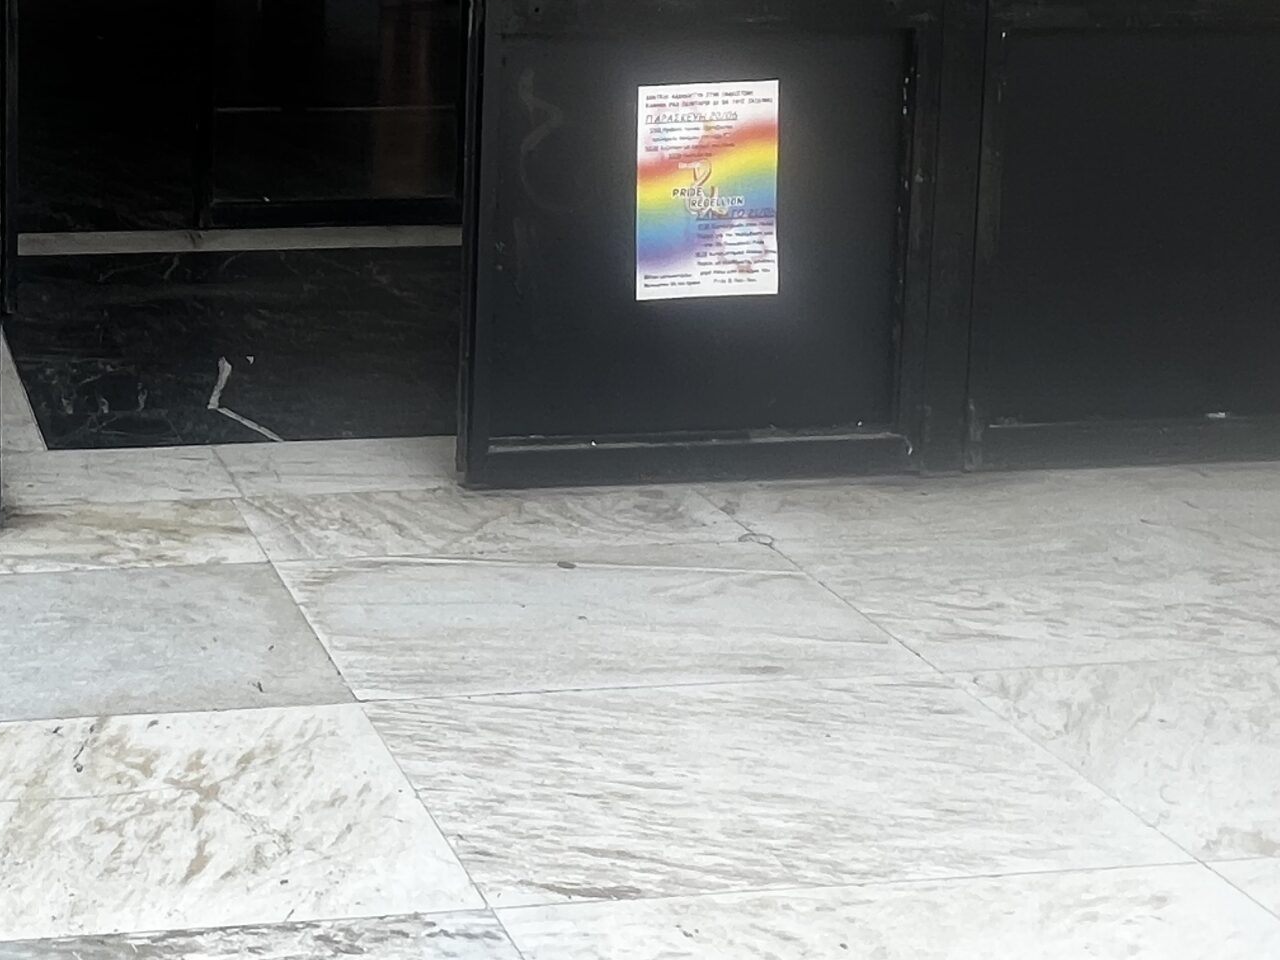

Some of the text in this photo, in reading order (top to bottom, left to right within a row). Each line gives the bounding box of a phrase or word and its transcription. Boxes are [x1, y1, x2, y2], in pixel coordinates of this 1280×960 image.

[645, 112, 706, 124] ΠΑΡΑΣΚΕΥΗ
[672, 187, 703, 197] PRIDE
[691, 197, 742, 208] REBELLION
